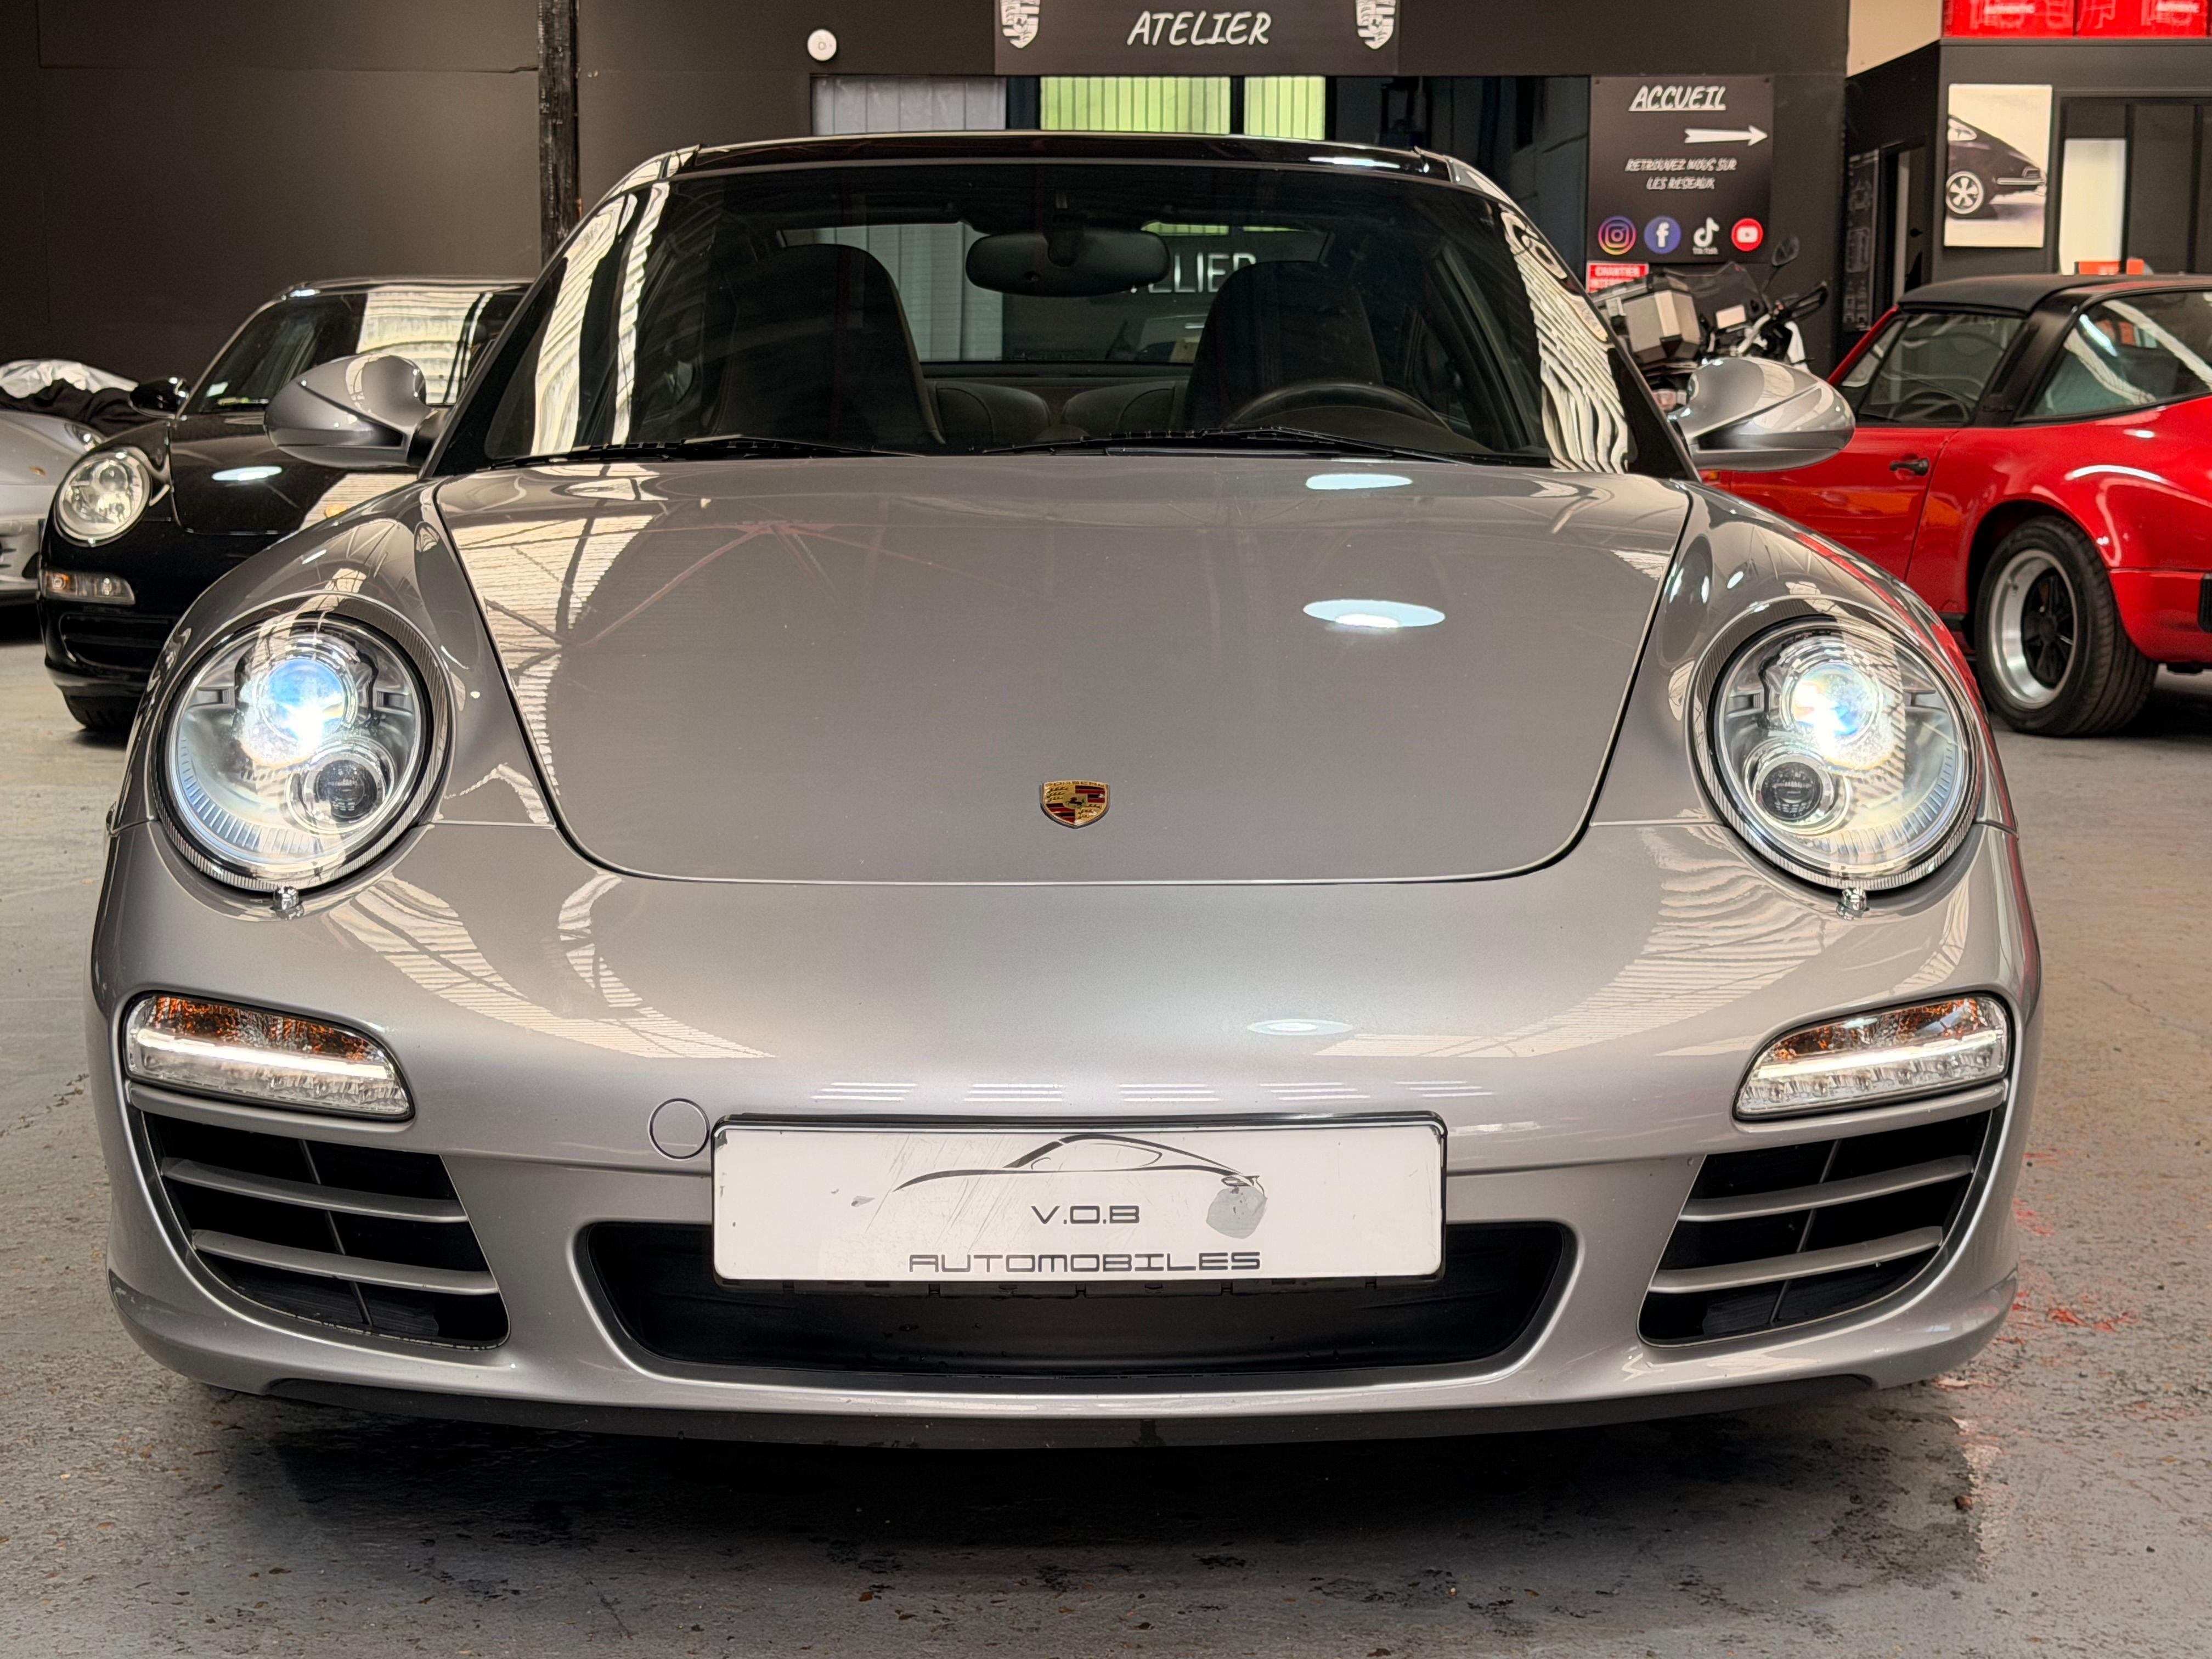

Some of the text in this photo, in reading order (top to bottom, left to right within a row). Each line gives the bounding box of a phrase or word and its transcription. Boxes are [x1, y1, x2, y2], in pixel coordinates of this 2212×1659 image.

[1127, 10, 1272, 46] ATELIER
[1629, 85, 1727, 110] ACCUEIL
[1625, 158, 1686, 172] RETROUVEZ
[1646, 176, 1668, 190] LES
[1031, 1205, 1139, 1224] V.O.B
[910, 1252, 1261, 1273] AUTOMOBILES
